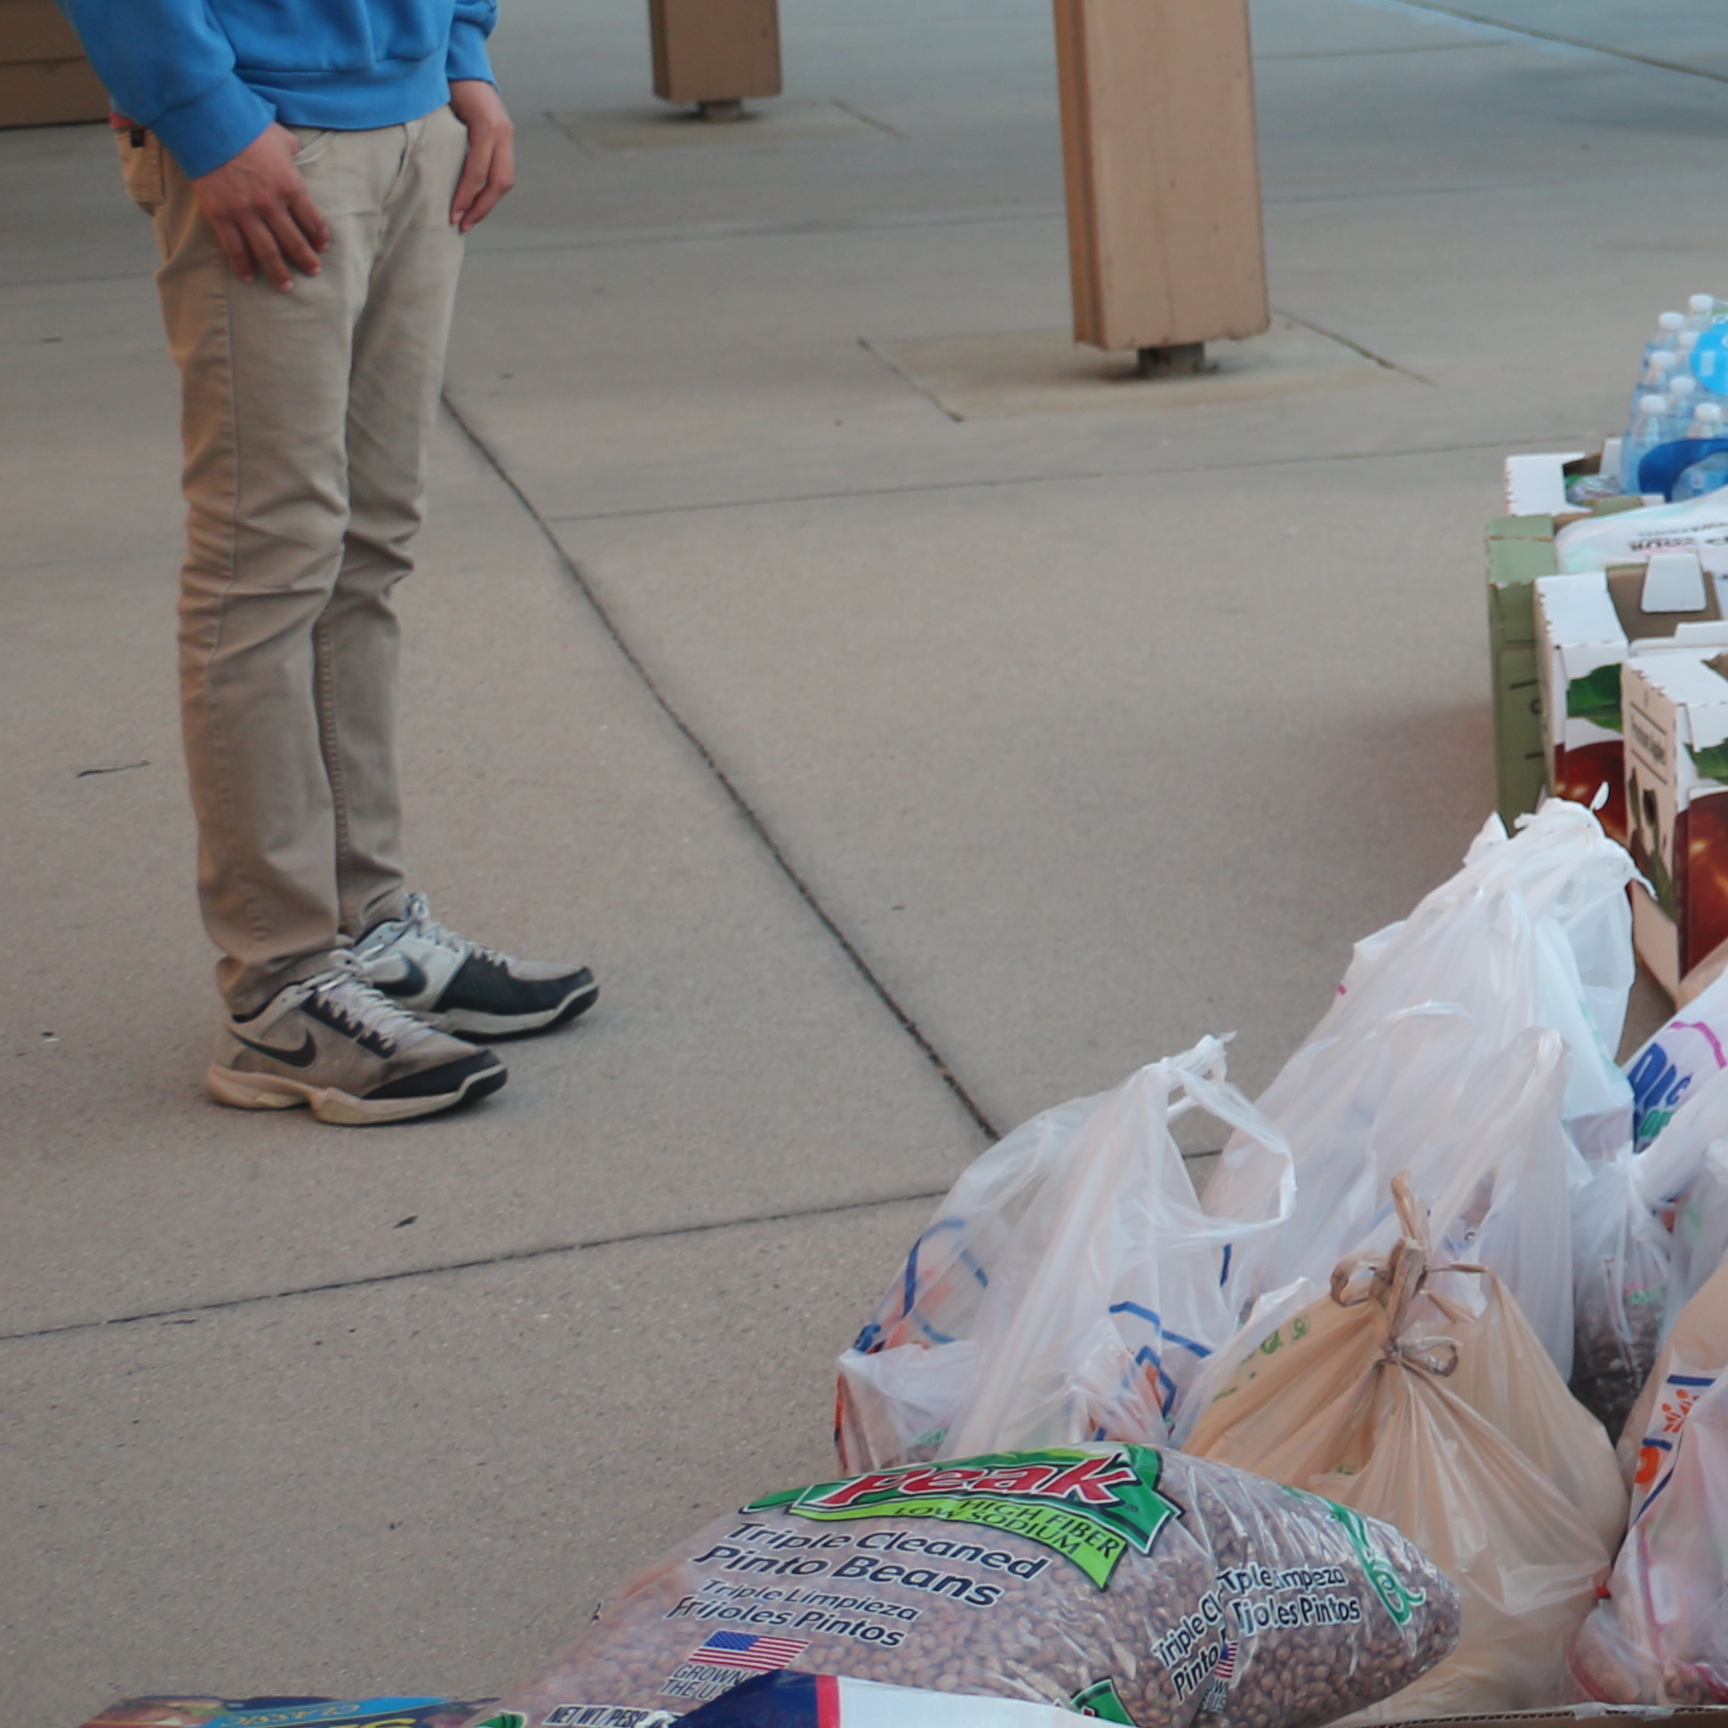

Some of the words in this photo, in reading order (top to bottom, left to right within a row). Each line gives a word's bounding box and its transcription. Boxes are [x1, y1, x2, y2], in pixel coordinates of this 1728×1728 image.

[725, 1522, 852, 1553] Triple
[856, 1530, 1051, 1581] Cleaned
[956, 1498, 1045, 1522] HIGH
[1051, 1513, 1120, 1560] FIBER
[968, 1510, 1081, 1555] SODIUM
[693, 1544, 832, 1578] Pinto
[830, 1554, 1004, 1608] Beans
[665, 1595, 801, 1628] Frijoles
[796, 1610, 907, 1647] Pintos
[699, 1579, 782, 1604] Triple
[783, 1586, 920, 1622] Limpieza
[1299, 1596, 1361, 1624] Pintos
[1153, 1611, 1202, 1669] Triple
[659, 1678, 697, 1699] THE
[673, 1663, 745, 1686] GROWN
